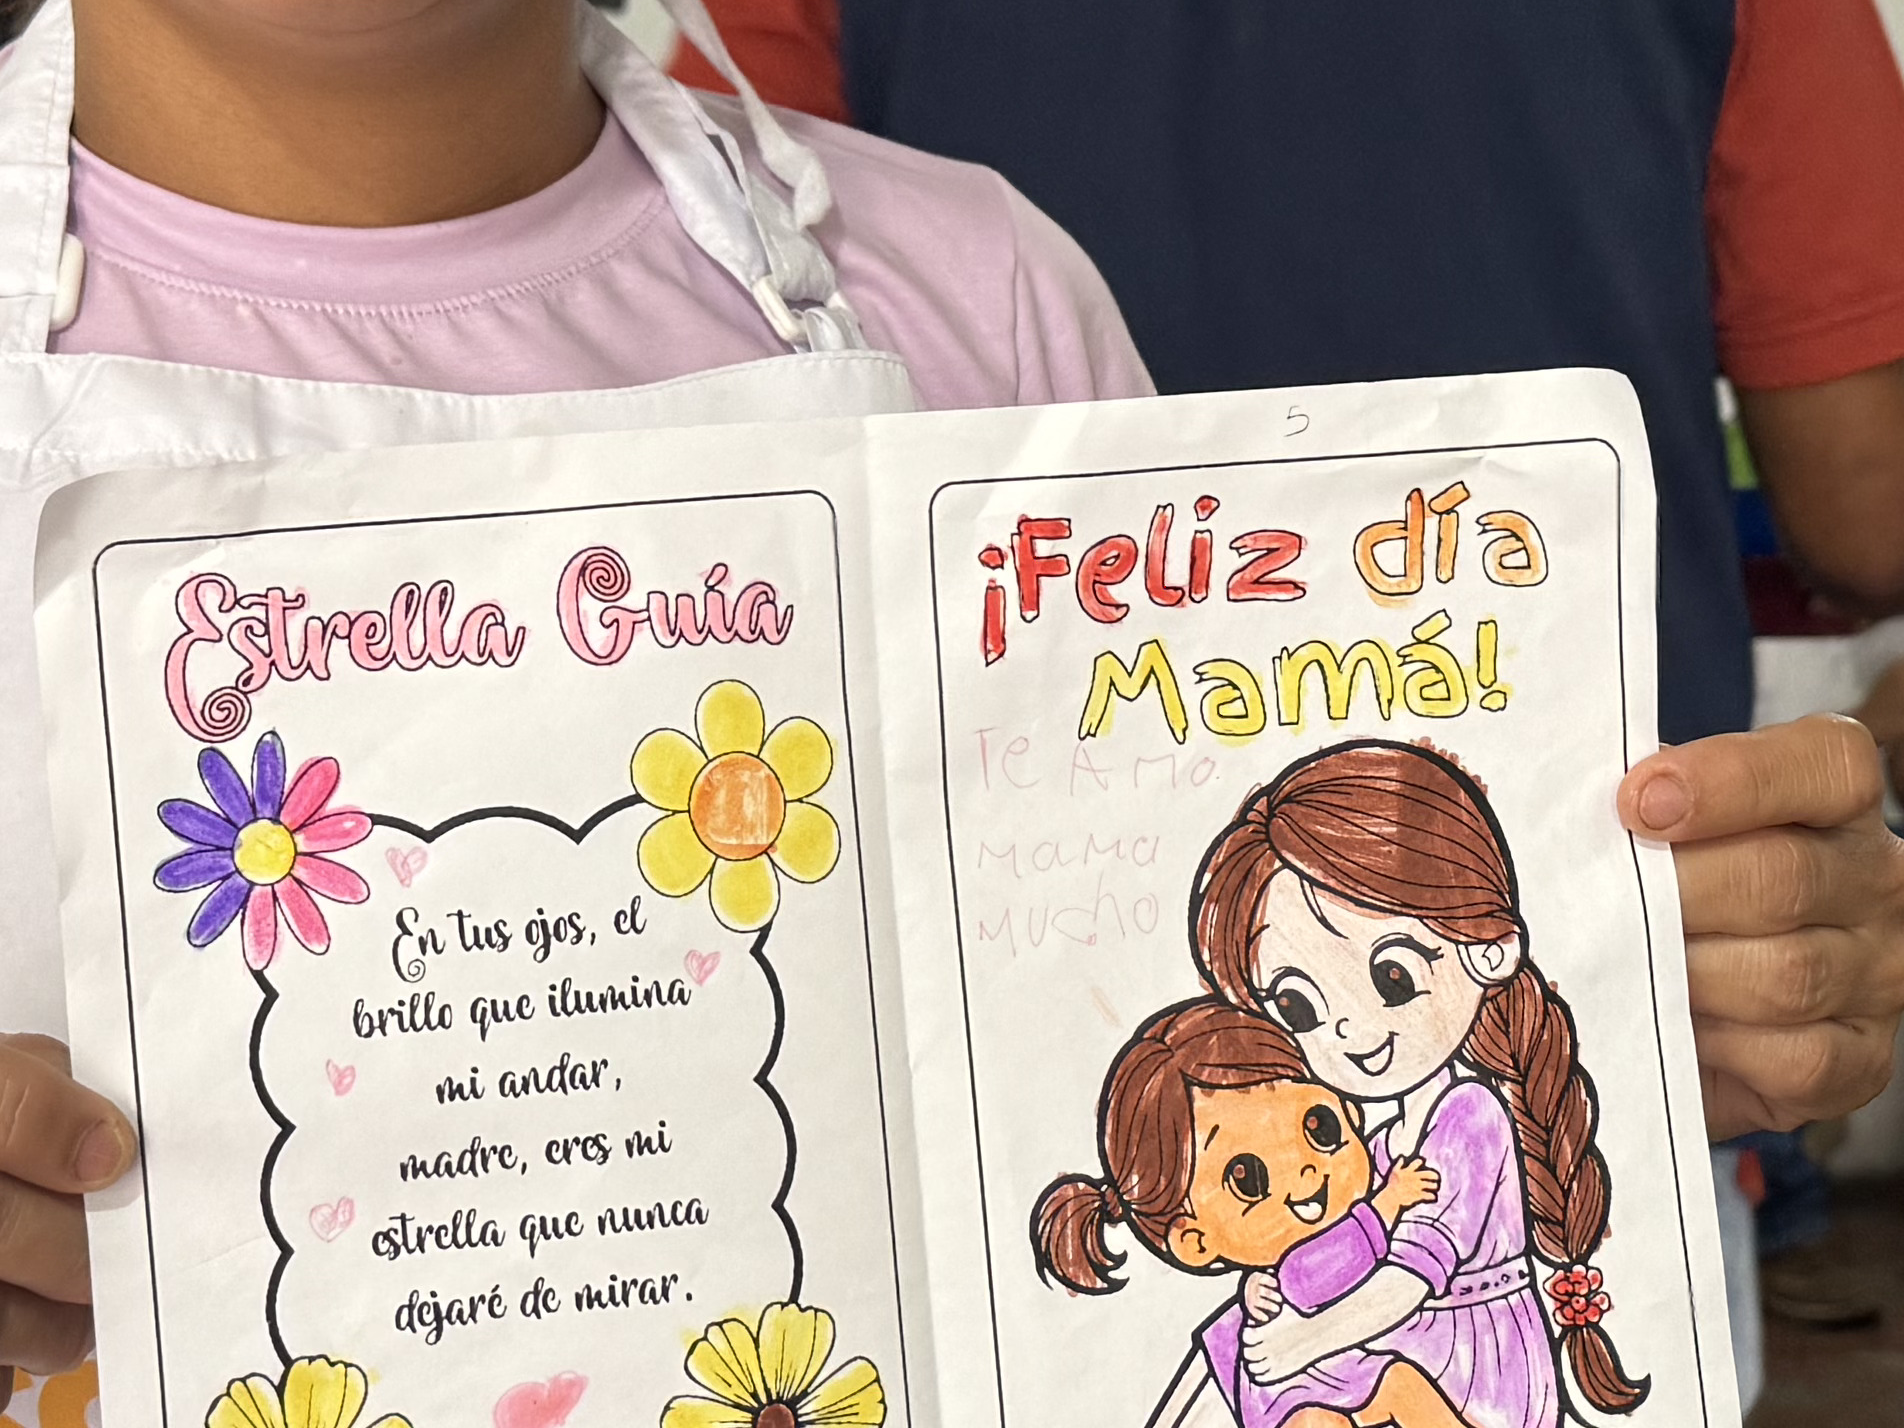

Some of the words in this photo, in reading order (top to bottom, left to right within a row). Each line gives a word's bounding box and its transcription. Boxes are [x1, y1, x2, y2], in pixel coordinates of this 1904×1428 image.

[1287, 408, 1308, 436] 5
[978, 495, 1310, 667] ¡Feliz
[1353, 481, 1548, 596] día
[165, 573, 525, 742] Estrella
[557, 546, 793, 665] Guía
[1078, 608, 1507, 745] Mamá!
[393, 908, 446, 982] En
[448, 910, 512, 952] tus
[526, 908, 595, 963] ojos,
[614, 896, 646, 934] el
[353, 988, 453, 1038] brillo
[471, 995, 534, 1041] que
[549, 976, 691, 1016] ilumina
[436, 1067, 484, 1103] mi
[499, 1058, 620, 1098] andar,
[400, 1137, 526, 1181] madre,
[546, 1134, 611, 1165] eres
[626, 1121, 672, 1158] mi
[372, 1210, 505, 1260] estrella
[520, 1212, 583, 1258] que
[598, 1199, 708, 1234] nunca
[396, 1285, 506, 1345] dejaré
[521, 1277, 560, 1319] de
[575, 1274, 692, 1311] mirar.
